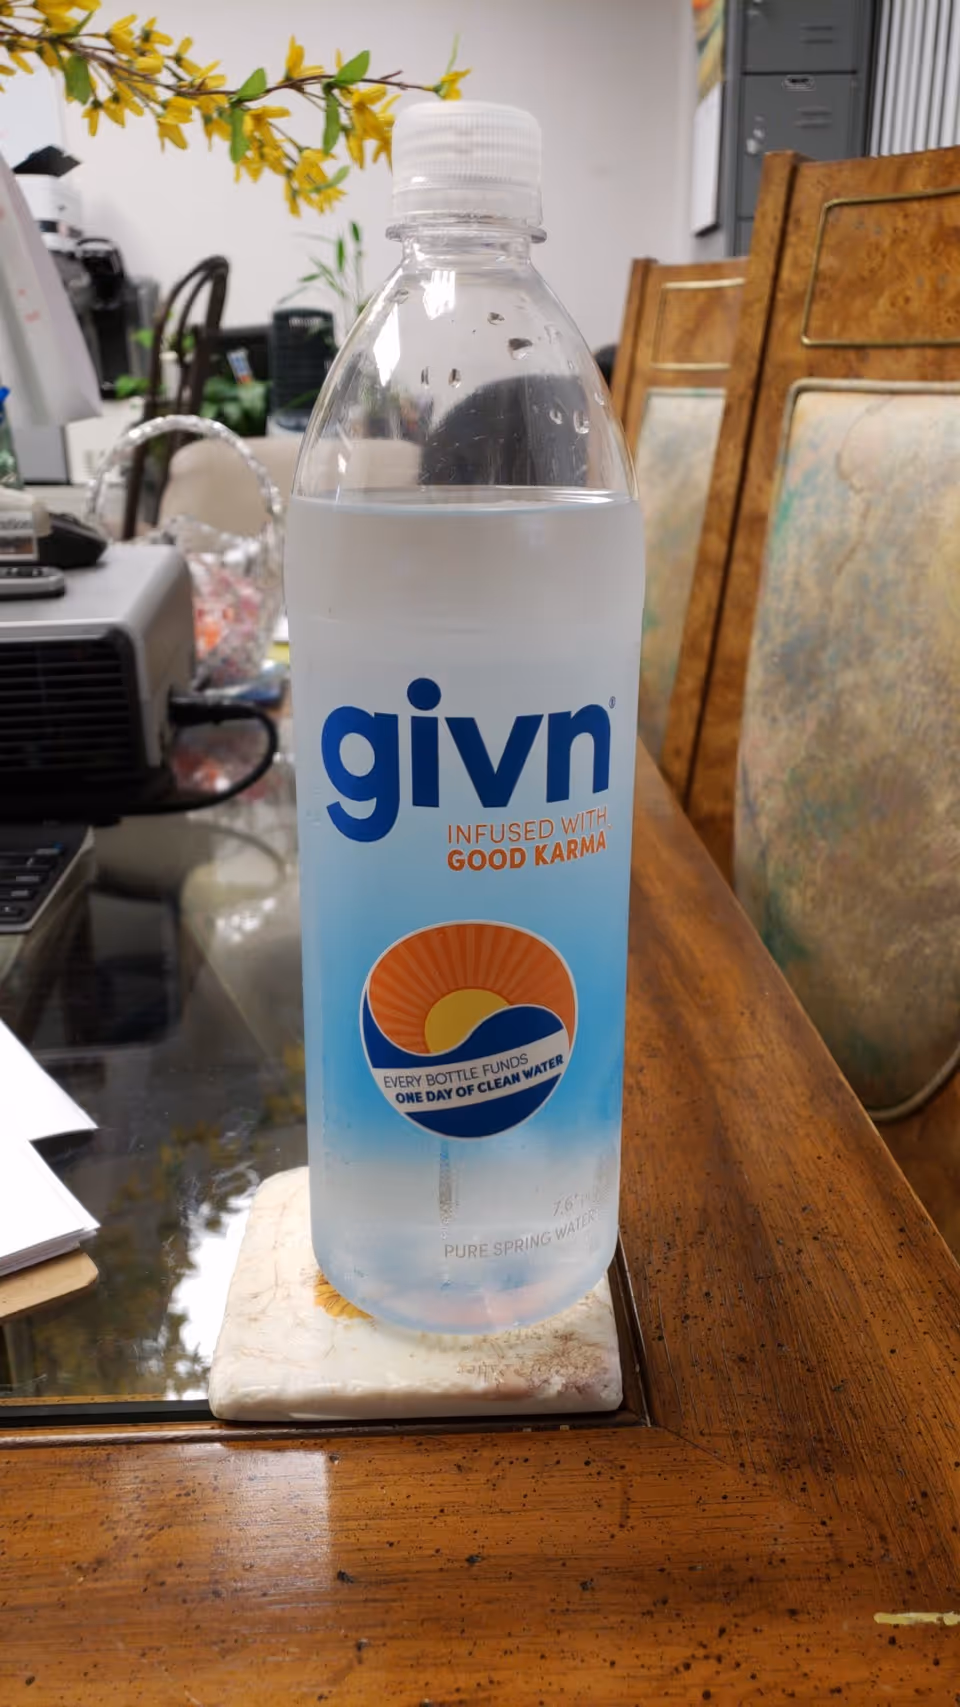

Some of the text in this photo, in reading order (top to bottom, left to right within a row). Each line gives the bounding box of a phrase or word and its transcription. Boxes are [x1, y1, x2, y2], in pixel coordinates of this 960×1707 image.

[321, 677, 611, 843] givn
[447, 818, 554, 845] INFUSED
[447, 831, 607, 871] GOOD KARMA
[383, 1053, 529, 1089] EVERY BOTTLE FUNDS
[395, 1054, 564, 1104] ONE DAY OF CLEAN WATER
[444, 1208, 595, 1259] PURE SPRING WATER
